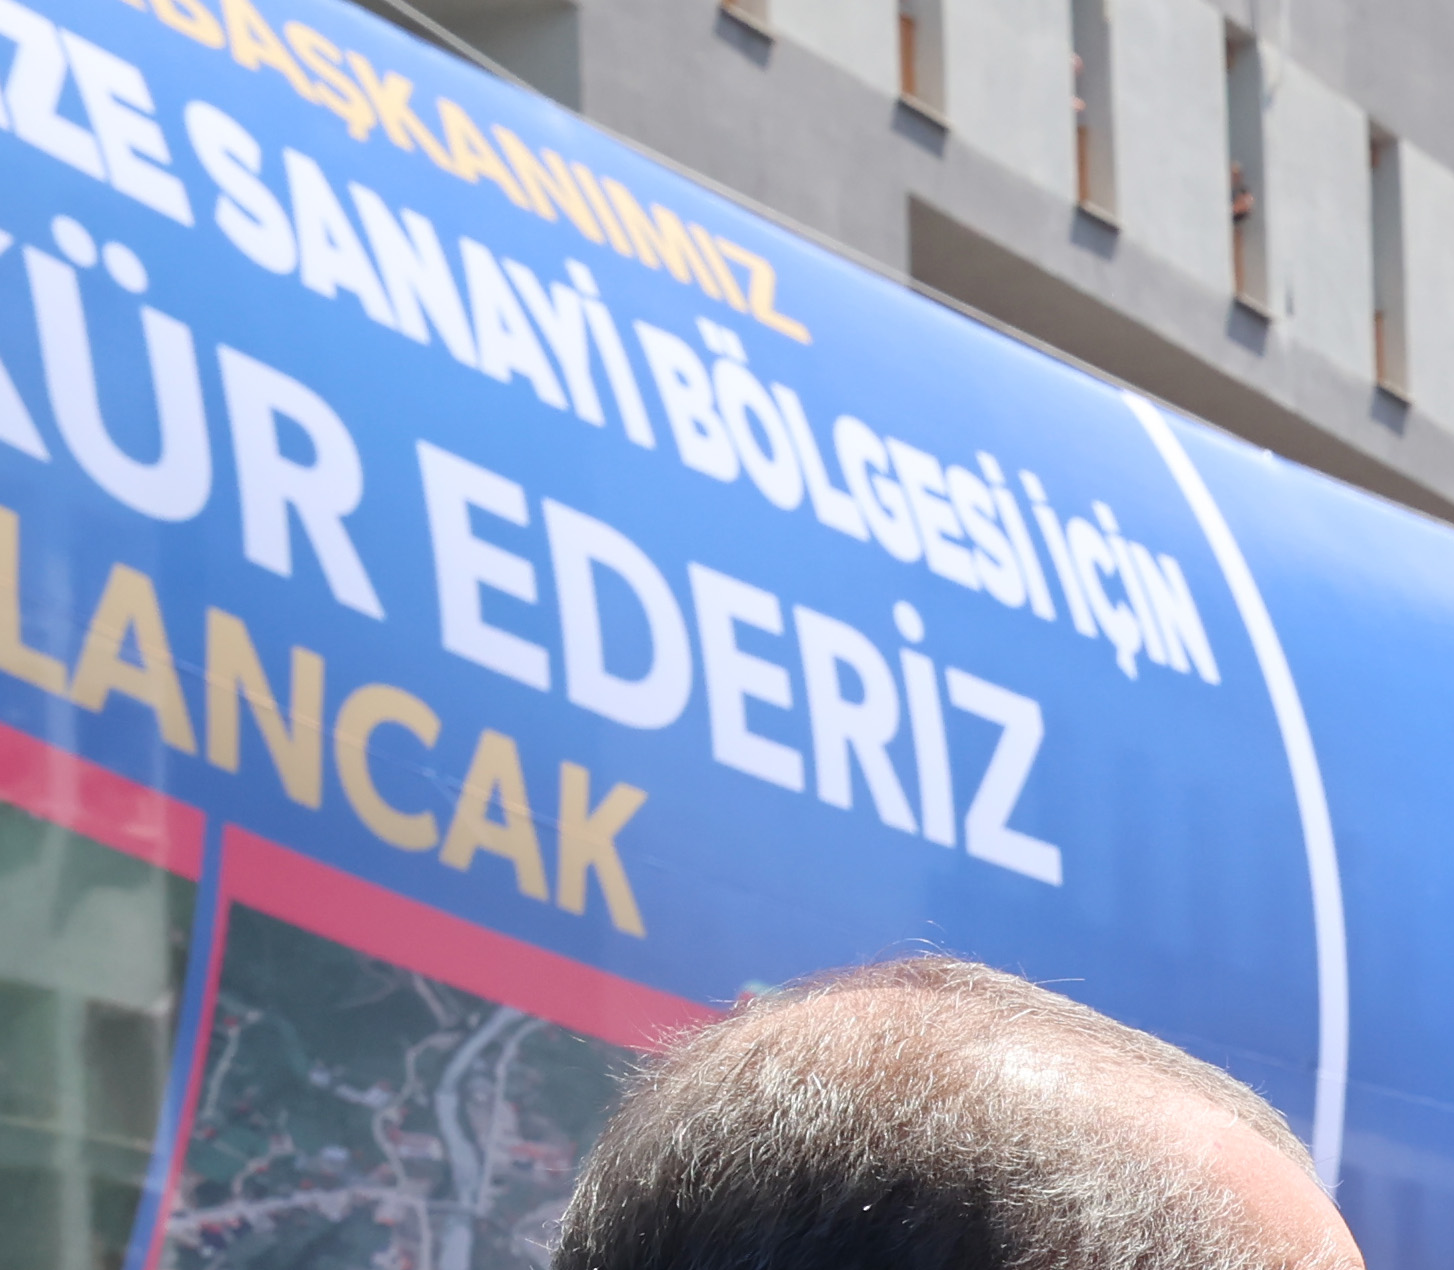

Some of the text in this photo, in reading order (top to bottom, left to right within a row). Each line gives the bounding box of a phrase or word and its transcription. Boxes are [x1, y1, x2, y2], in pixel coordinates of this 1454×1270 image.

[0, 0, 1221, 686] ZE SANAYİ BÖLGESİ İÇİN
[118, 0, 812, 345] BAŞKANIMIZ
[417, 439, 1063, 887] EDERİZ
